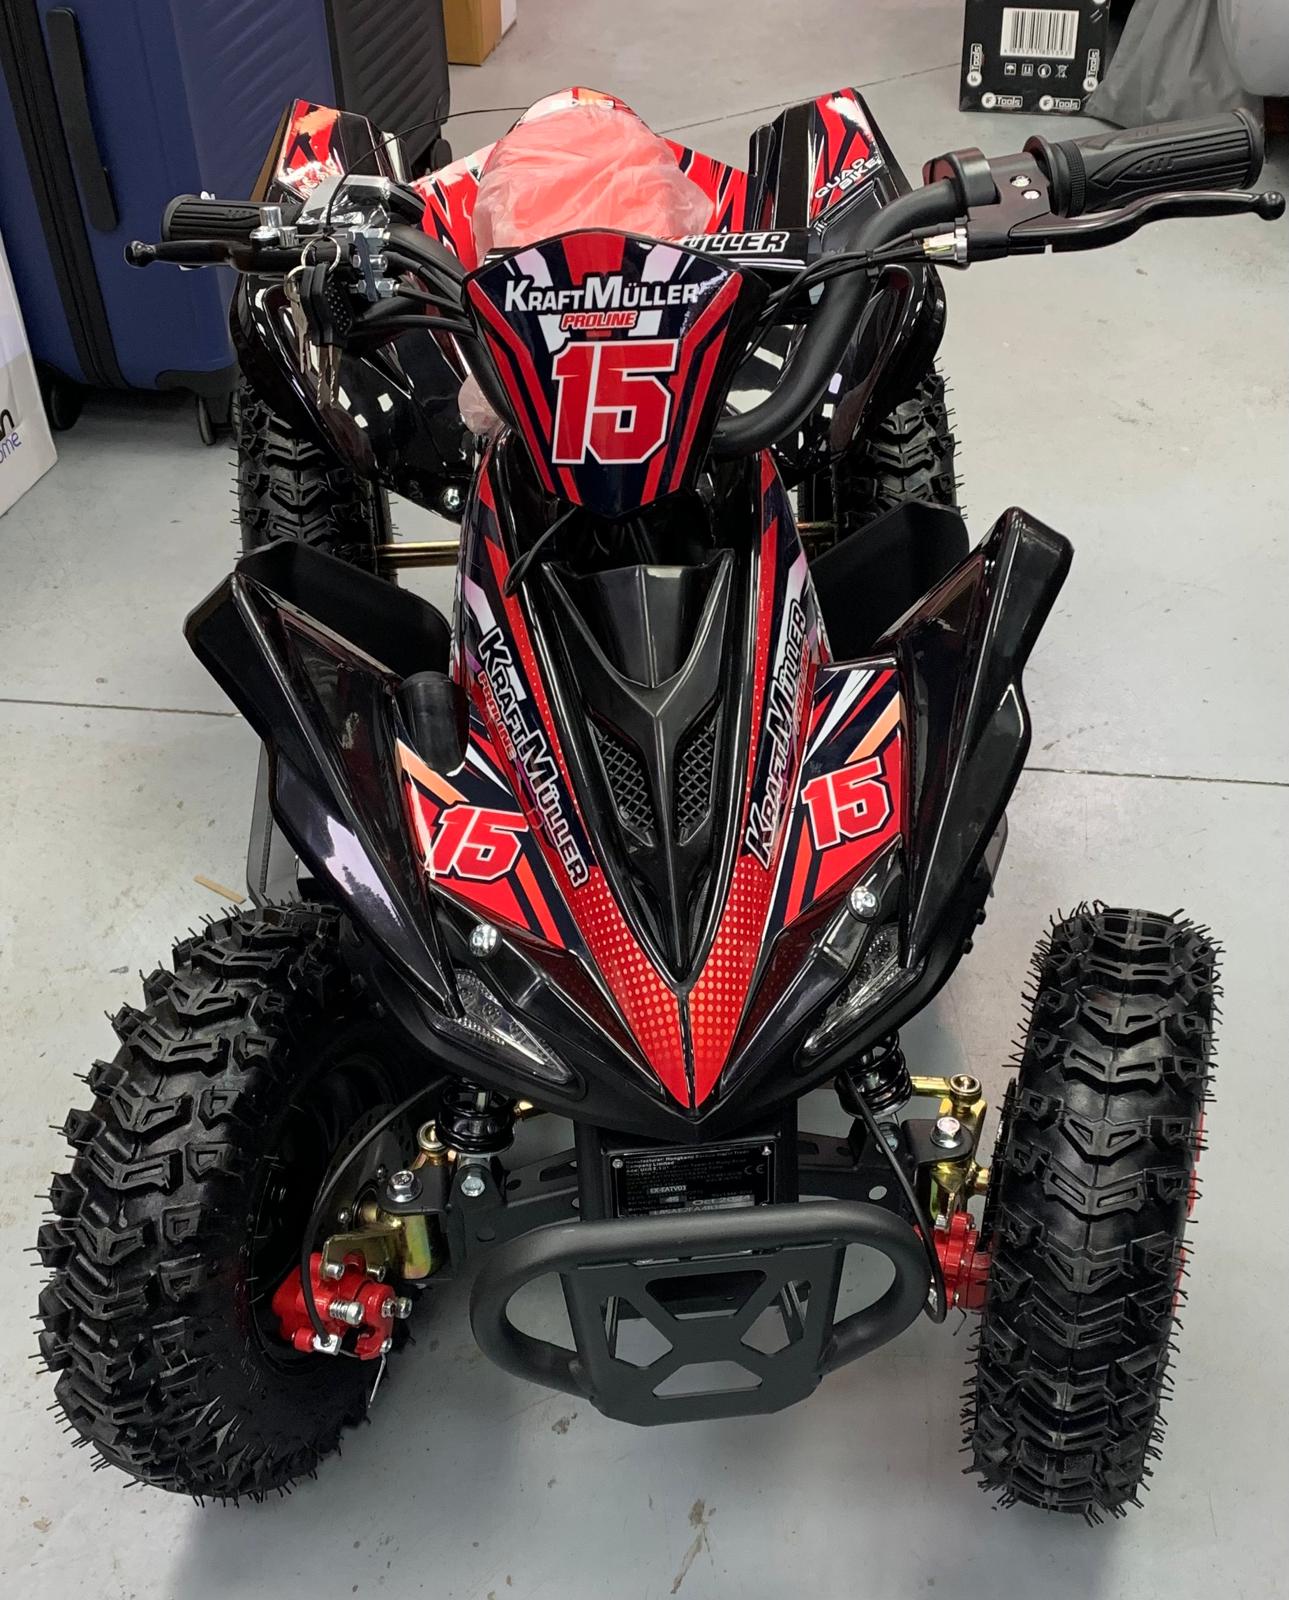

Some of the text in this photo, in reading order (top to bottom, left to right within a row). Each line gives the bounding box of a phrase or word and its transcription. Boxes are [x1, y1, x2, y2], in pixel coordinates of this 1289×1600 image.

[996, 96, 1021, 107] Tools
[1054, 99, 1080, 109] Tools
[815, 158, 865, 198] QUAD
[504, 276, 700, 311] KRAFTMÜLLER
[561, 310, 638, 330] PROLINE
[551, 339, 680, 464] 15
[477, 670, 517, 761] PROLINE
[478, 627, 589, 888] KRAFTMÜLLER
[801, 756, 890, 850] 15
[426, 804, 529, 880] 15
